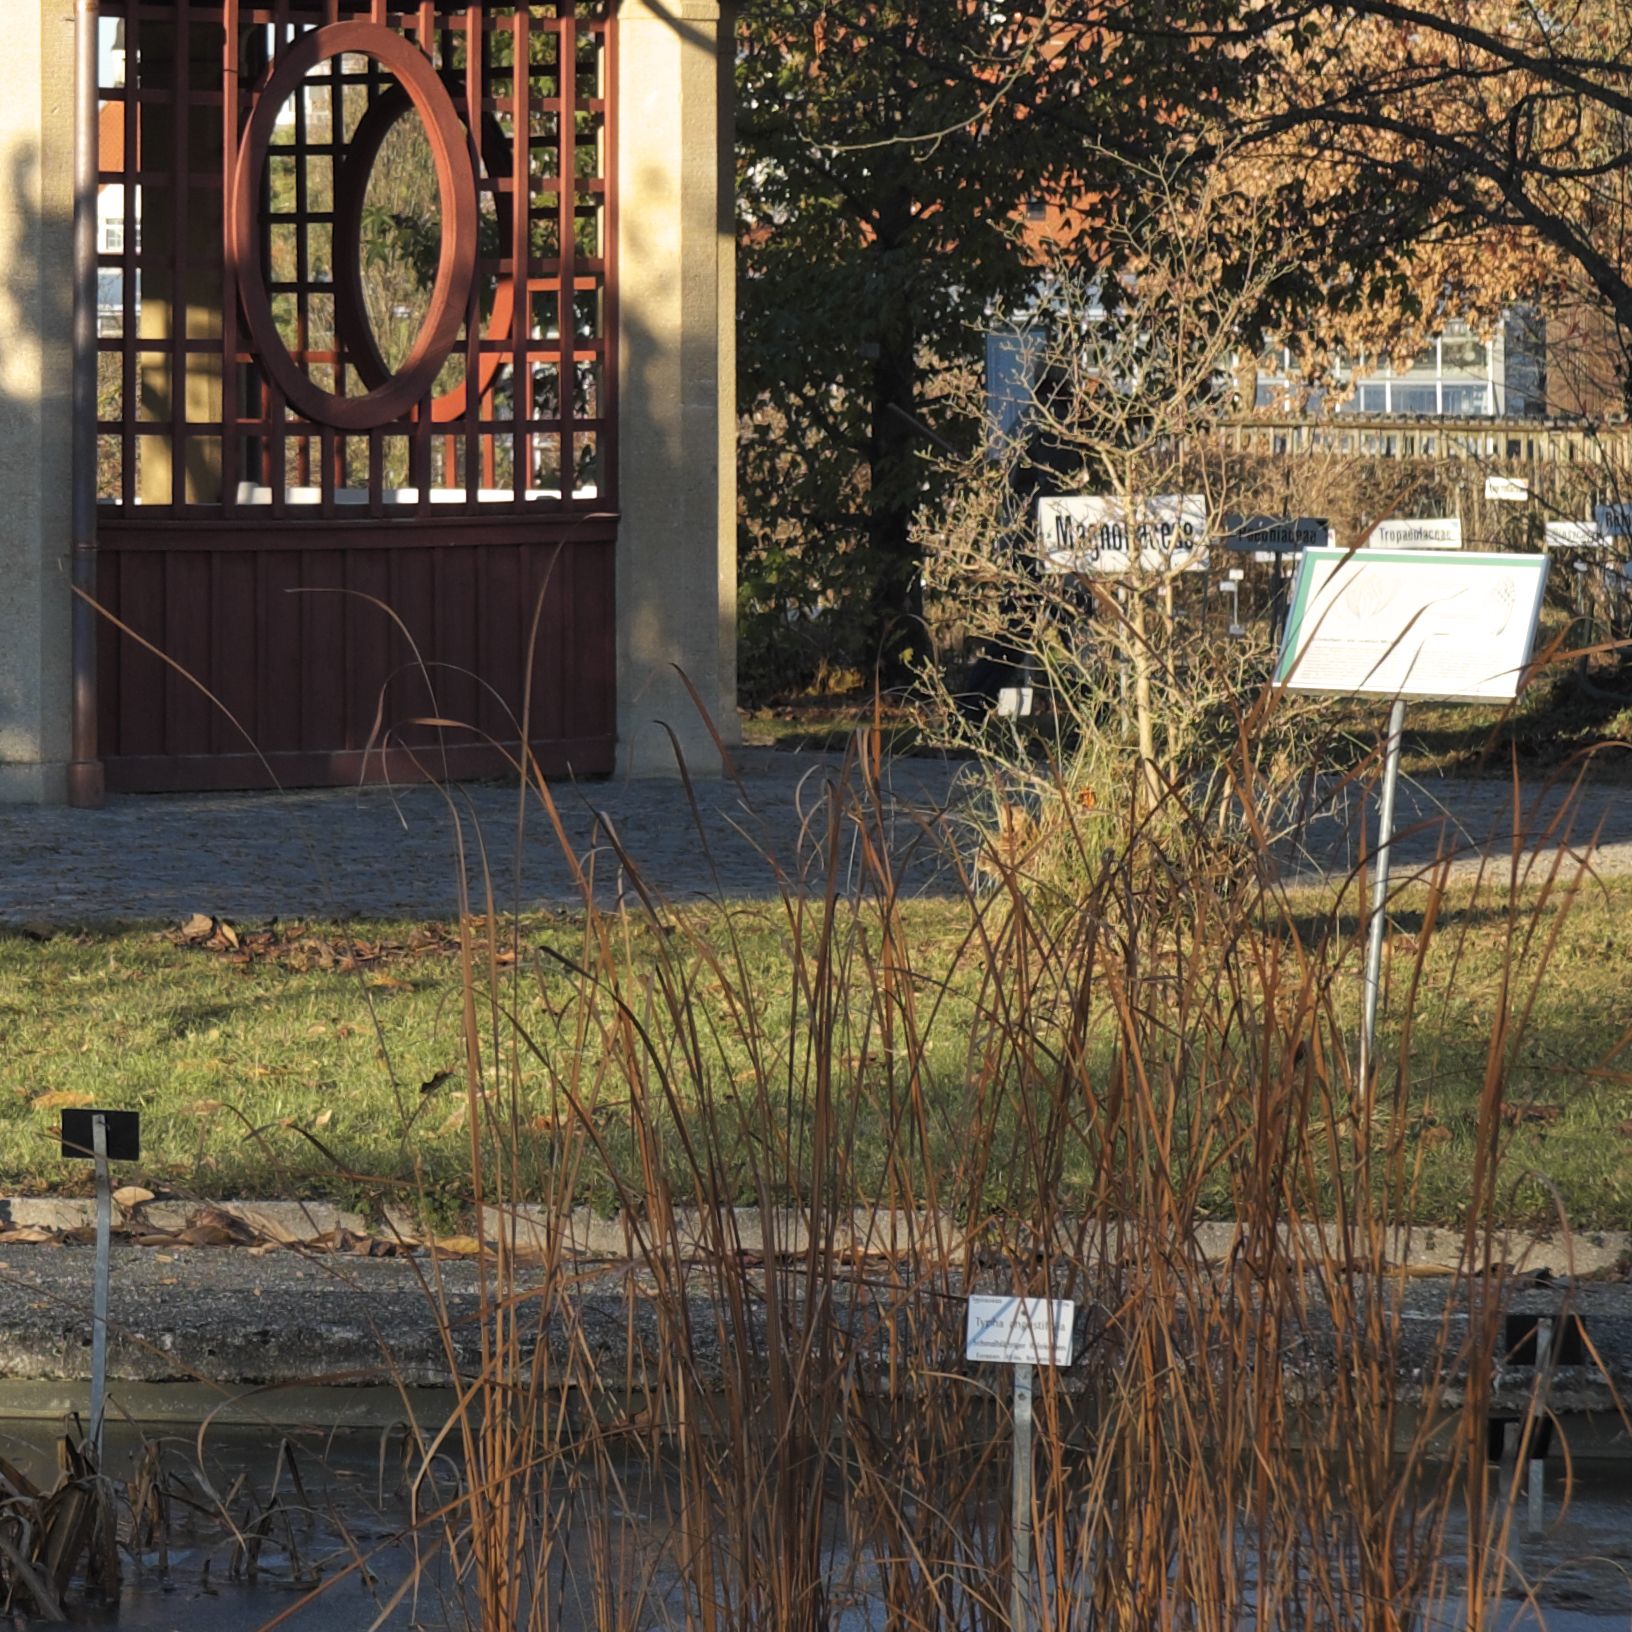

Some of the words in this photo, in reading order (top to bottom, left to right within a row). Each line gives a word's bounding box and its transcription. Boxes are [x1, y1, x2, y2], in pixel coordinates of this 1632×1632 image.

[1055, 515, 1194, 561] Magnolaceae
[1379, 527, 1452, 543] Tropaeolaceae
[976, 1316, 1004, 1330] Typha
